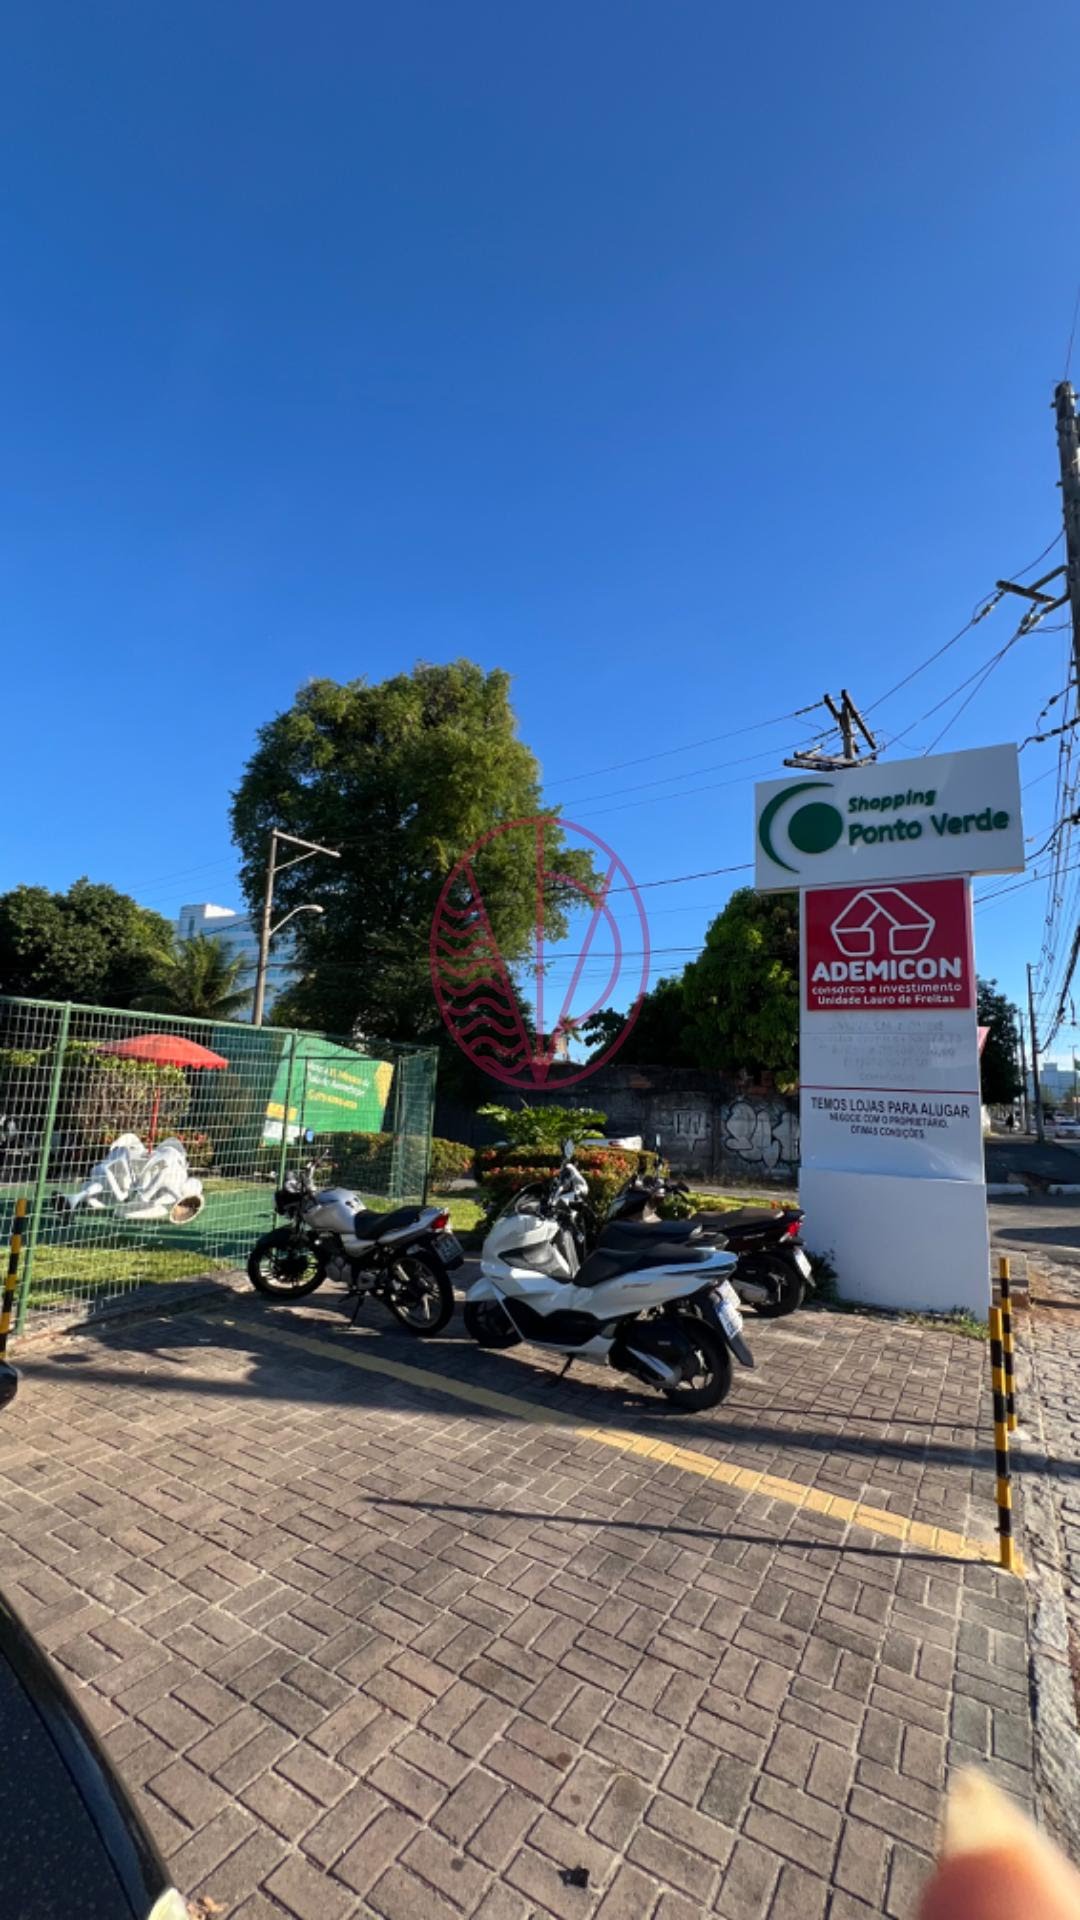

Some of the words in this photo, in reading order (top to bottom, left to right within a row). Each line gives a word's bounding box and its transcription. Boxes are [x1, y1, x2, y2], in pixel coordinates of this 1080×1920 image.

[848, 789, 936, 813] Shopping
[848, 818, 922, 846] Ponto
[930, 807, 1009, 836] Verde
[812, 957, 961, 981] ADEMICON
[869, 985, 876, 993] e
[879, 982, 962, 993] investimento
[818, 996, 861, 1005] Unidade
[864, 995, 895, 1005] Lauro
[898, 994, 912, 1004] de
[915, 994, 955, 1004] Freitas
[811, 1097, 846, 1110] TEMOS
[850, 1098, 884, 1113] LOJAS
[888, 1100, 917, 1115] PARA
[921, 1102, 970, 1118] ALUGAR
[864, 1114, 880, 1123] COM
[882, 1115, 888, 1124] O
